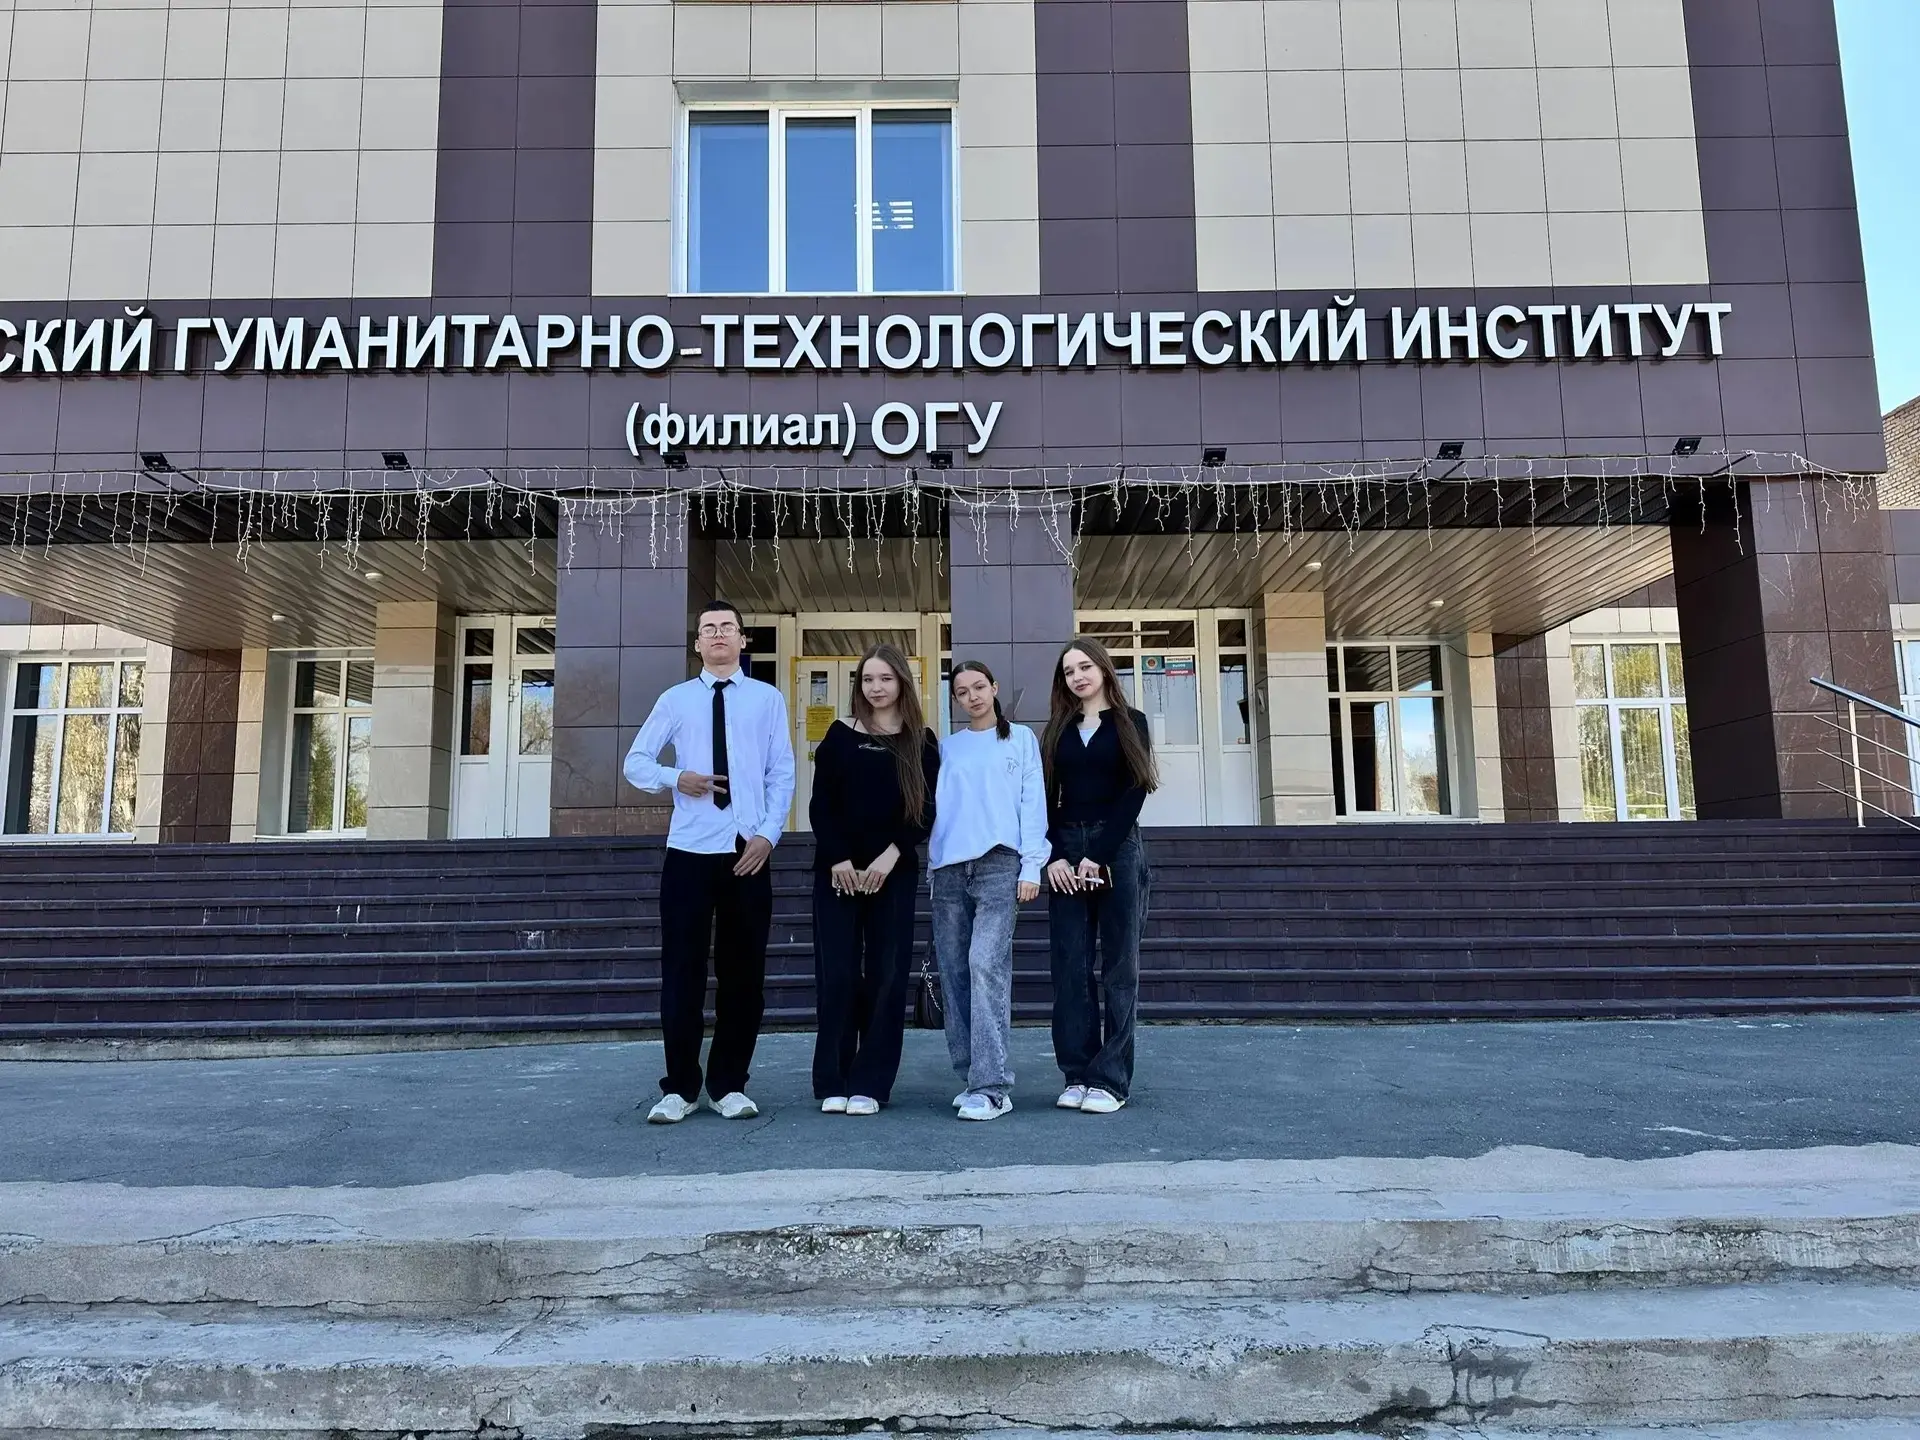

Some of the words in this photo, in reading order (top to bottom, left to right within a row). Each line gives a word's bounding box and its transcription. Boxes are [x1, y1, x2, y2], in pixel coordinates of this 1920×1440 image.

[174, 296, 1367, 371] ГУМАНИТАРНО-ТЕХНОЛОГИЧЕСКИЙ
[1391, 303, 1732, 360] ИНСТИТУТ
[626, 402, 856, 457] (филиал)
[871, 401, 1003, 456] ОГУ
